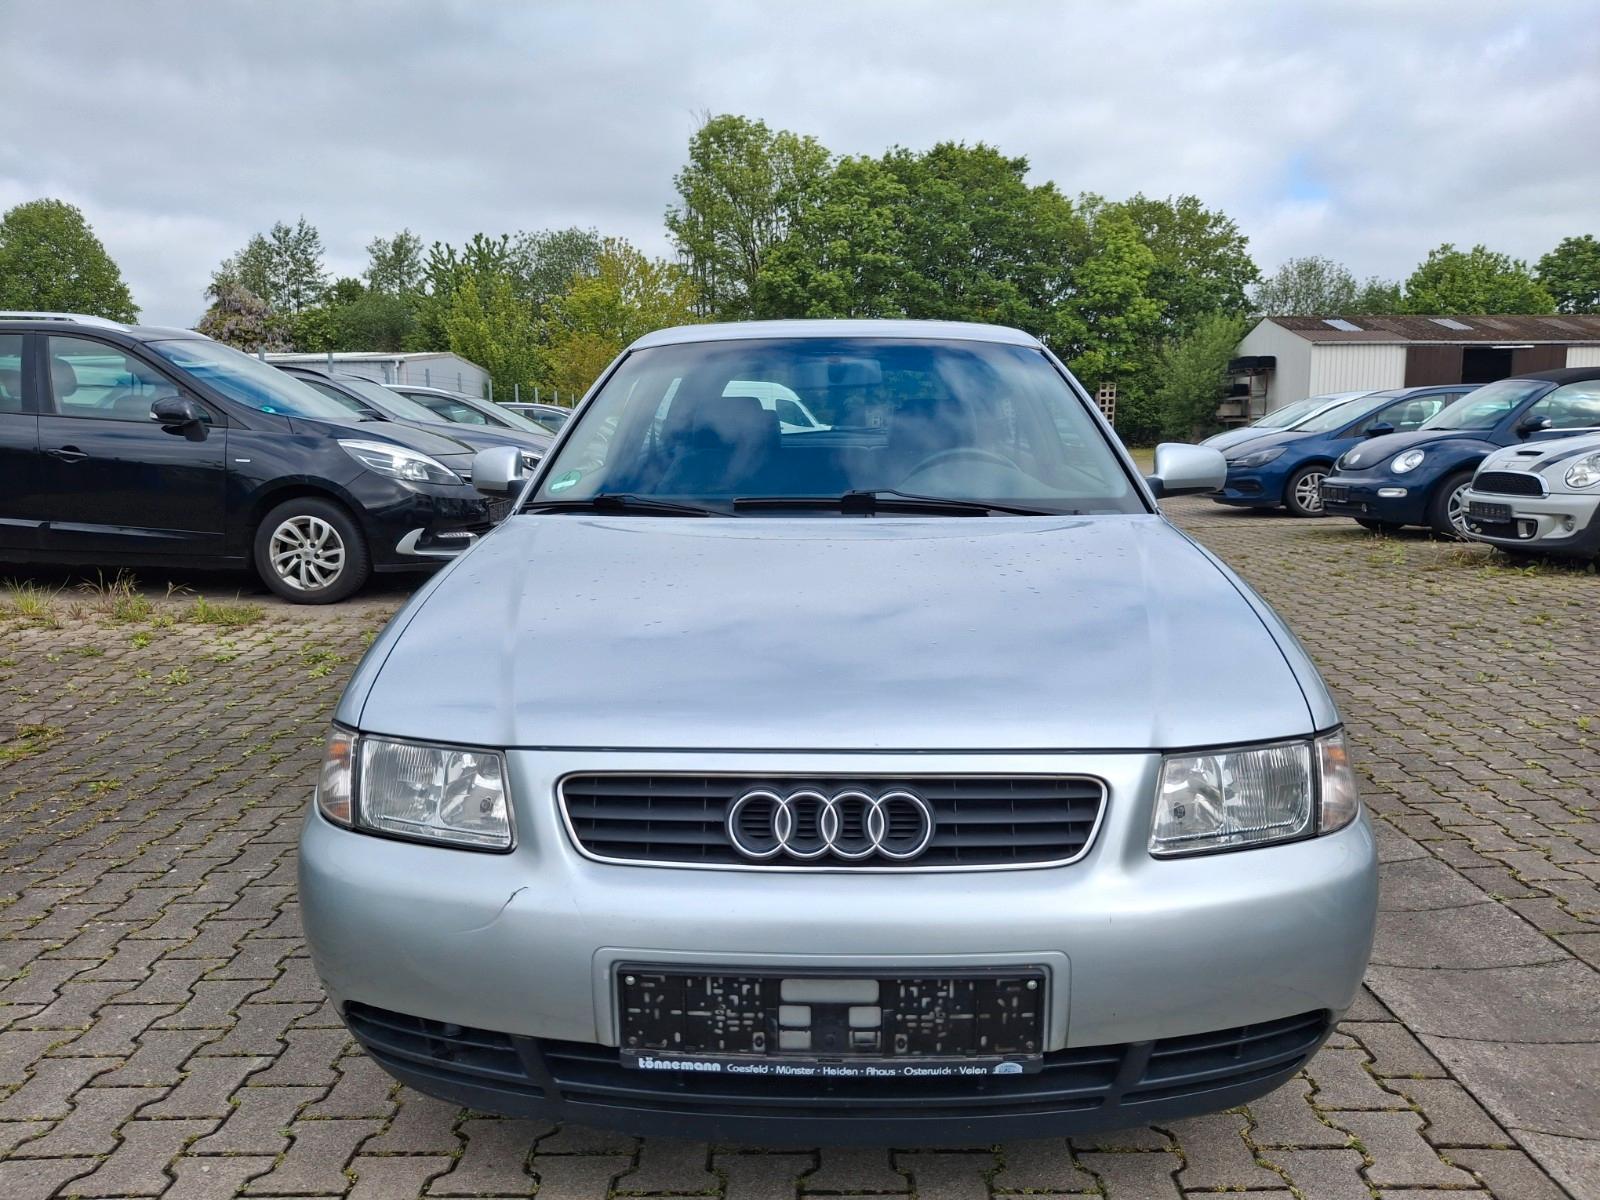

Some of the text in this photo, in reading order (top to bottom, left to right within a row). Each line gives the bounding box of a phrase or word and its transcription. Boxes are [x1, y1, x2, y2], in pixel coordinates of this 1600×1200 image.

[638, 1057, 721, 1071] tönnemann
[726, 1063, 769, 1074] Coesfeld
[775, 1065, 815, 1075] Münster
[822, 1066, 858, 1076] Heiden
[959, 1065, 987, 1075] Velen
